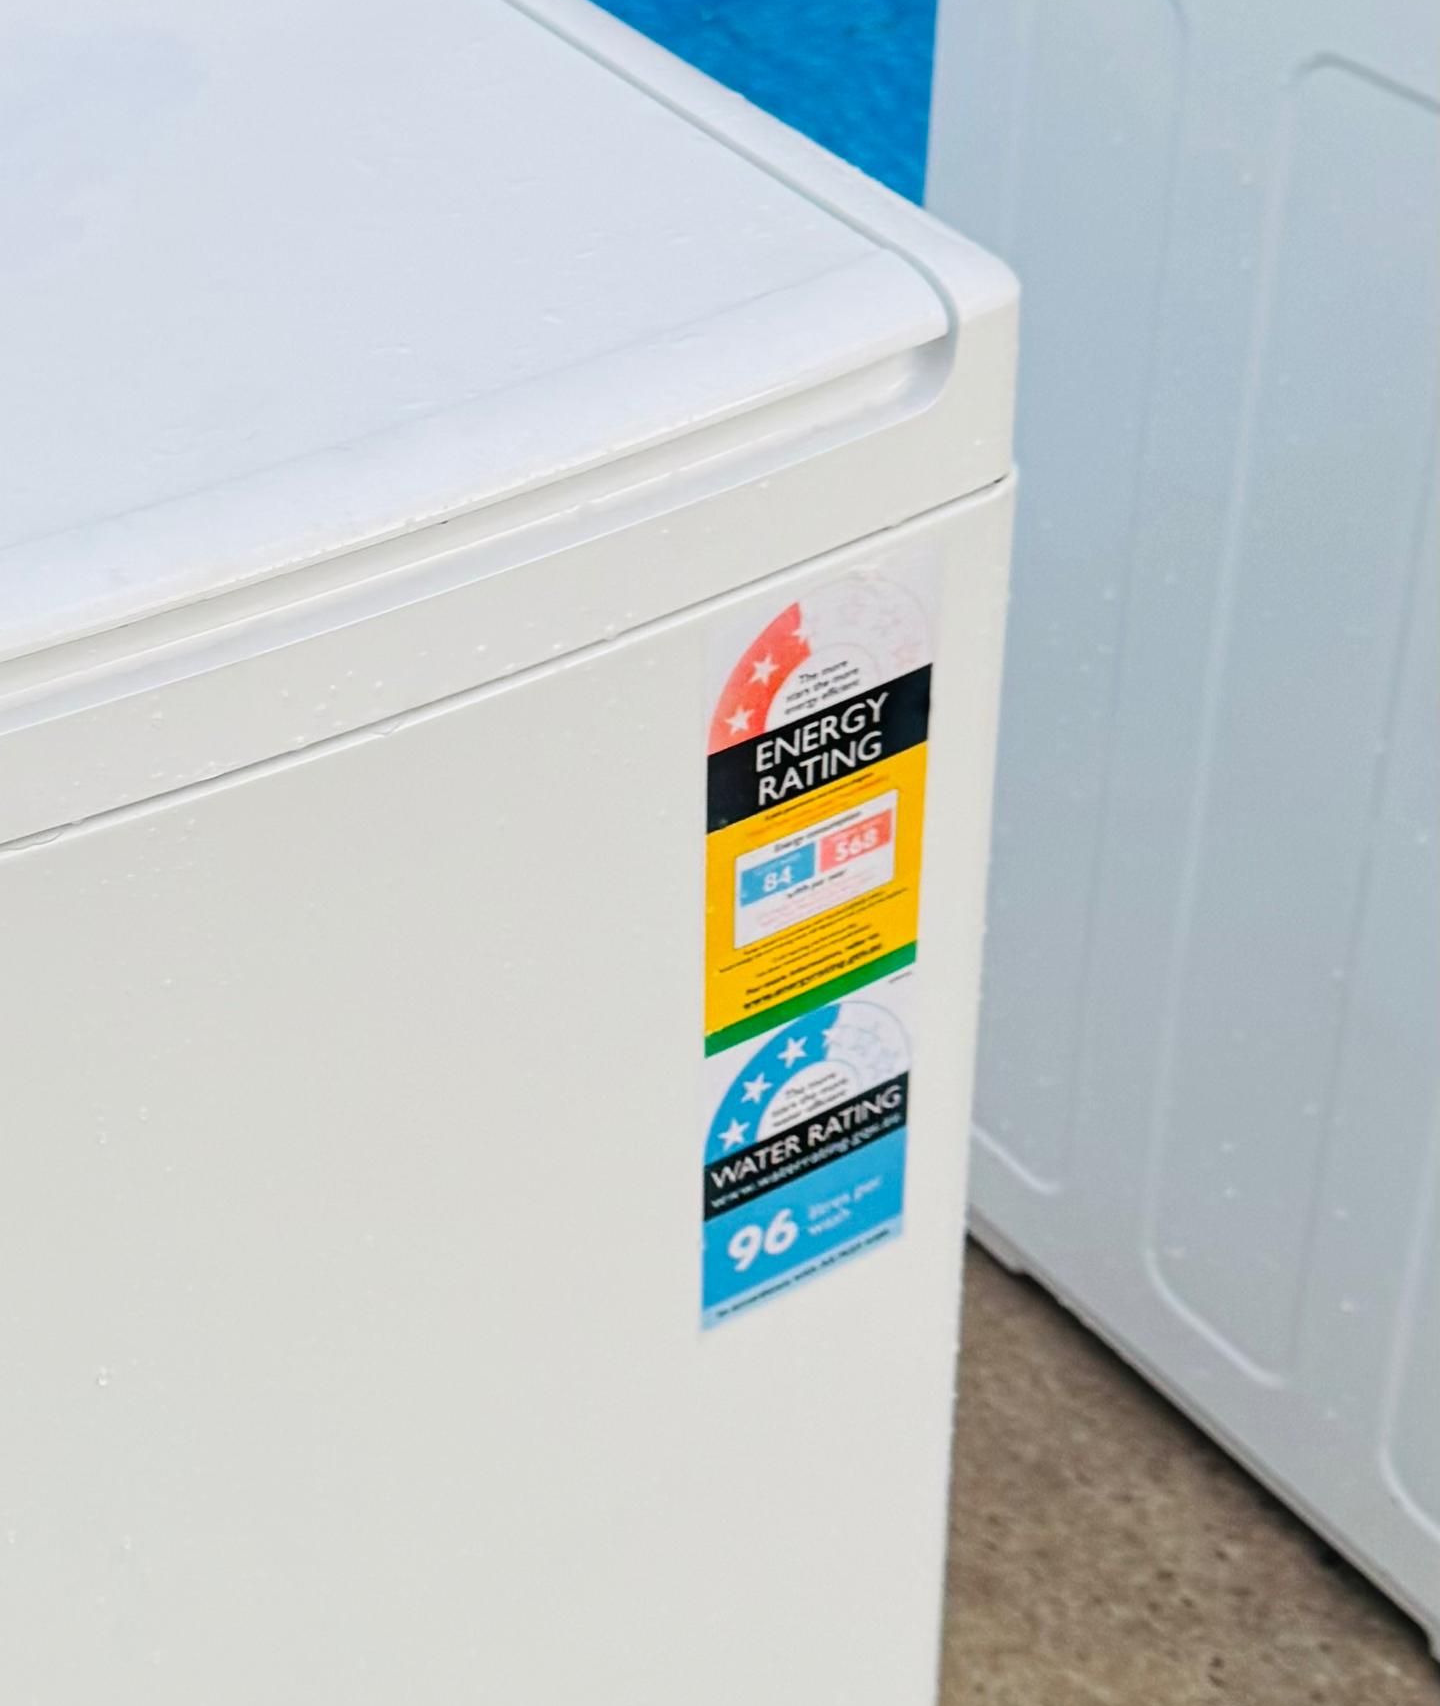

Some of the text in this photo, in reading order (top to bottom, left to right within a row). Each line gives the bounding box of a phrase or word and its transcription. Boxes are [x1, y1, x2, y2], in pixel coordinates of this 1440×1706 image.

[755, 692, 890, 773] ENERGY
[758, 730, 883, 806] RATING
[763, 865, 793, 893] 84
[710, 1084, 902, 1189] WATER RATING
[727, 1208, 800, 1273] 96
